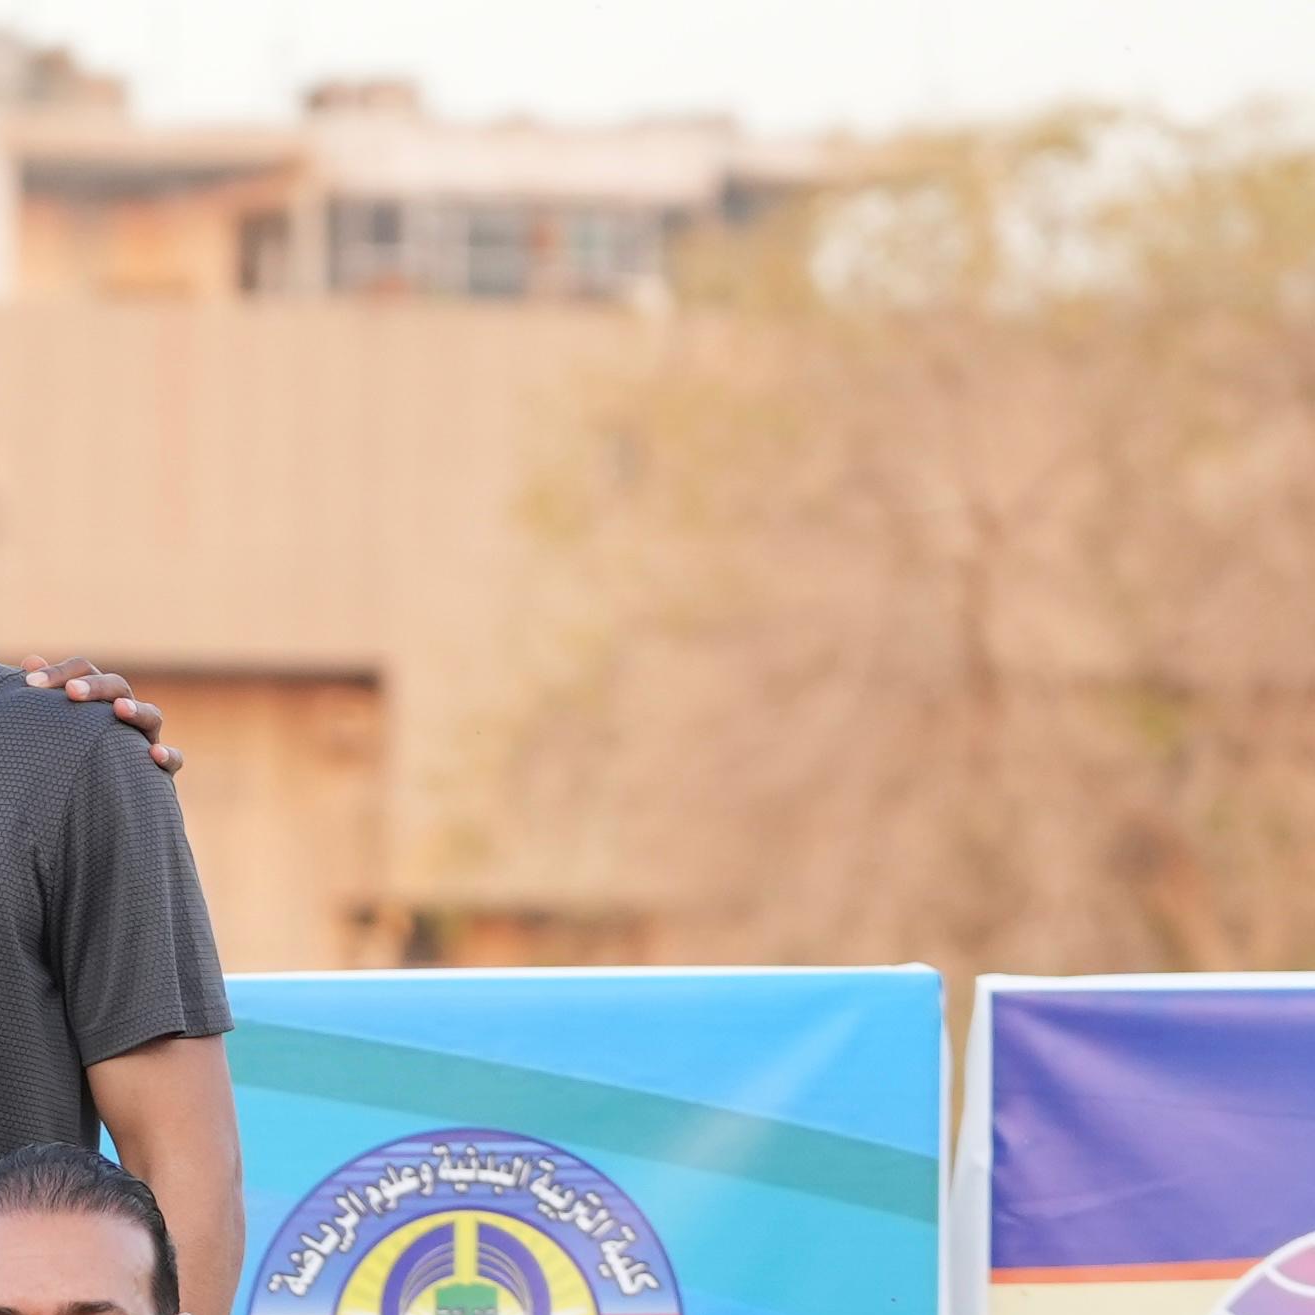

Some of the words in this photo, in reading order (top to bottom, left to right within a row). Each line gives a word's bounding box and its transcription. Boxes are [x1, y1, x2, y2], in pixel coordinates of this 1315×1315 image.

[365, 1161, 434, 1215] وعلوم
[432, 1143, 533, 1196] البدنية
[528, 1158, 617, 1239] التربية
[267, 1187, 368, 1297] الرياضة
[598, 1224, 660, 1297] كلية
